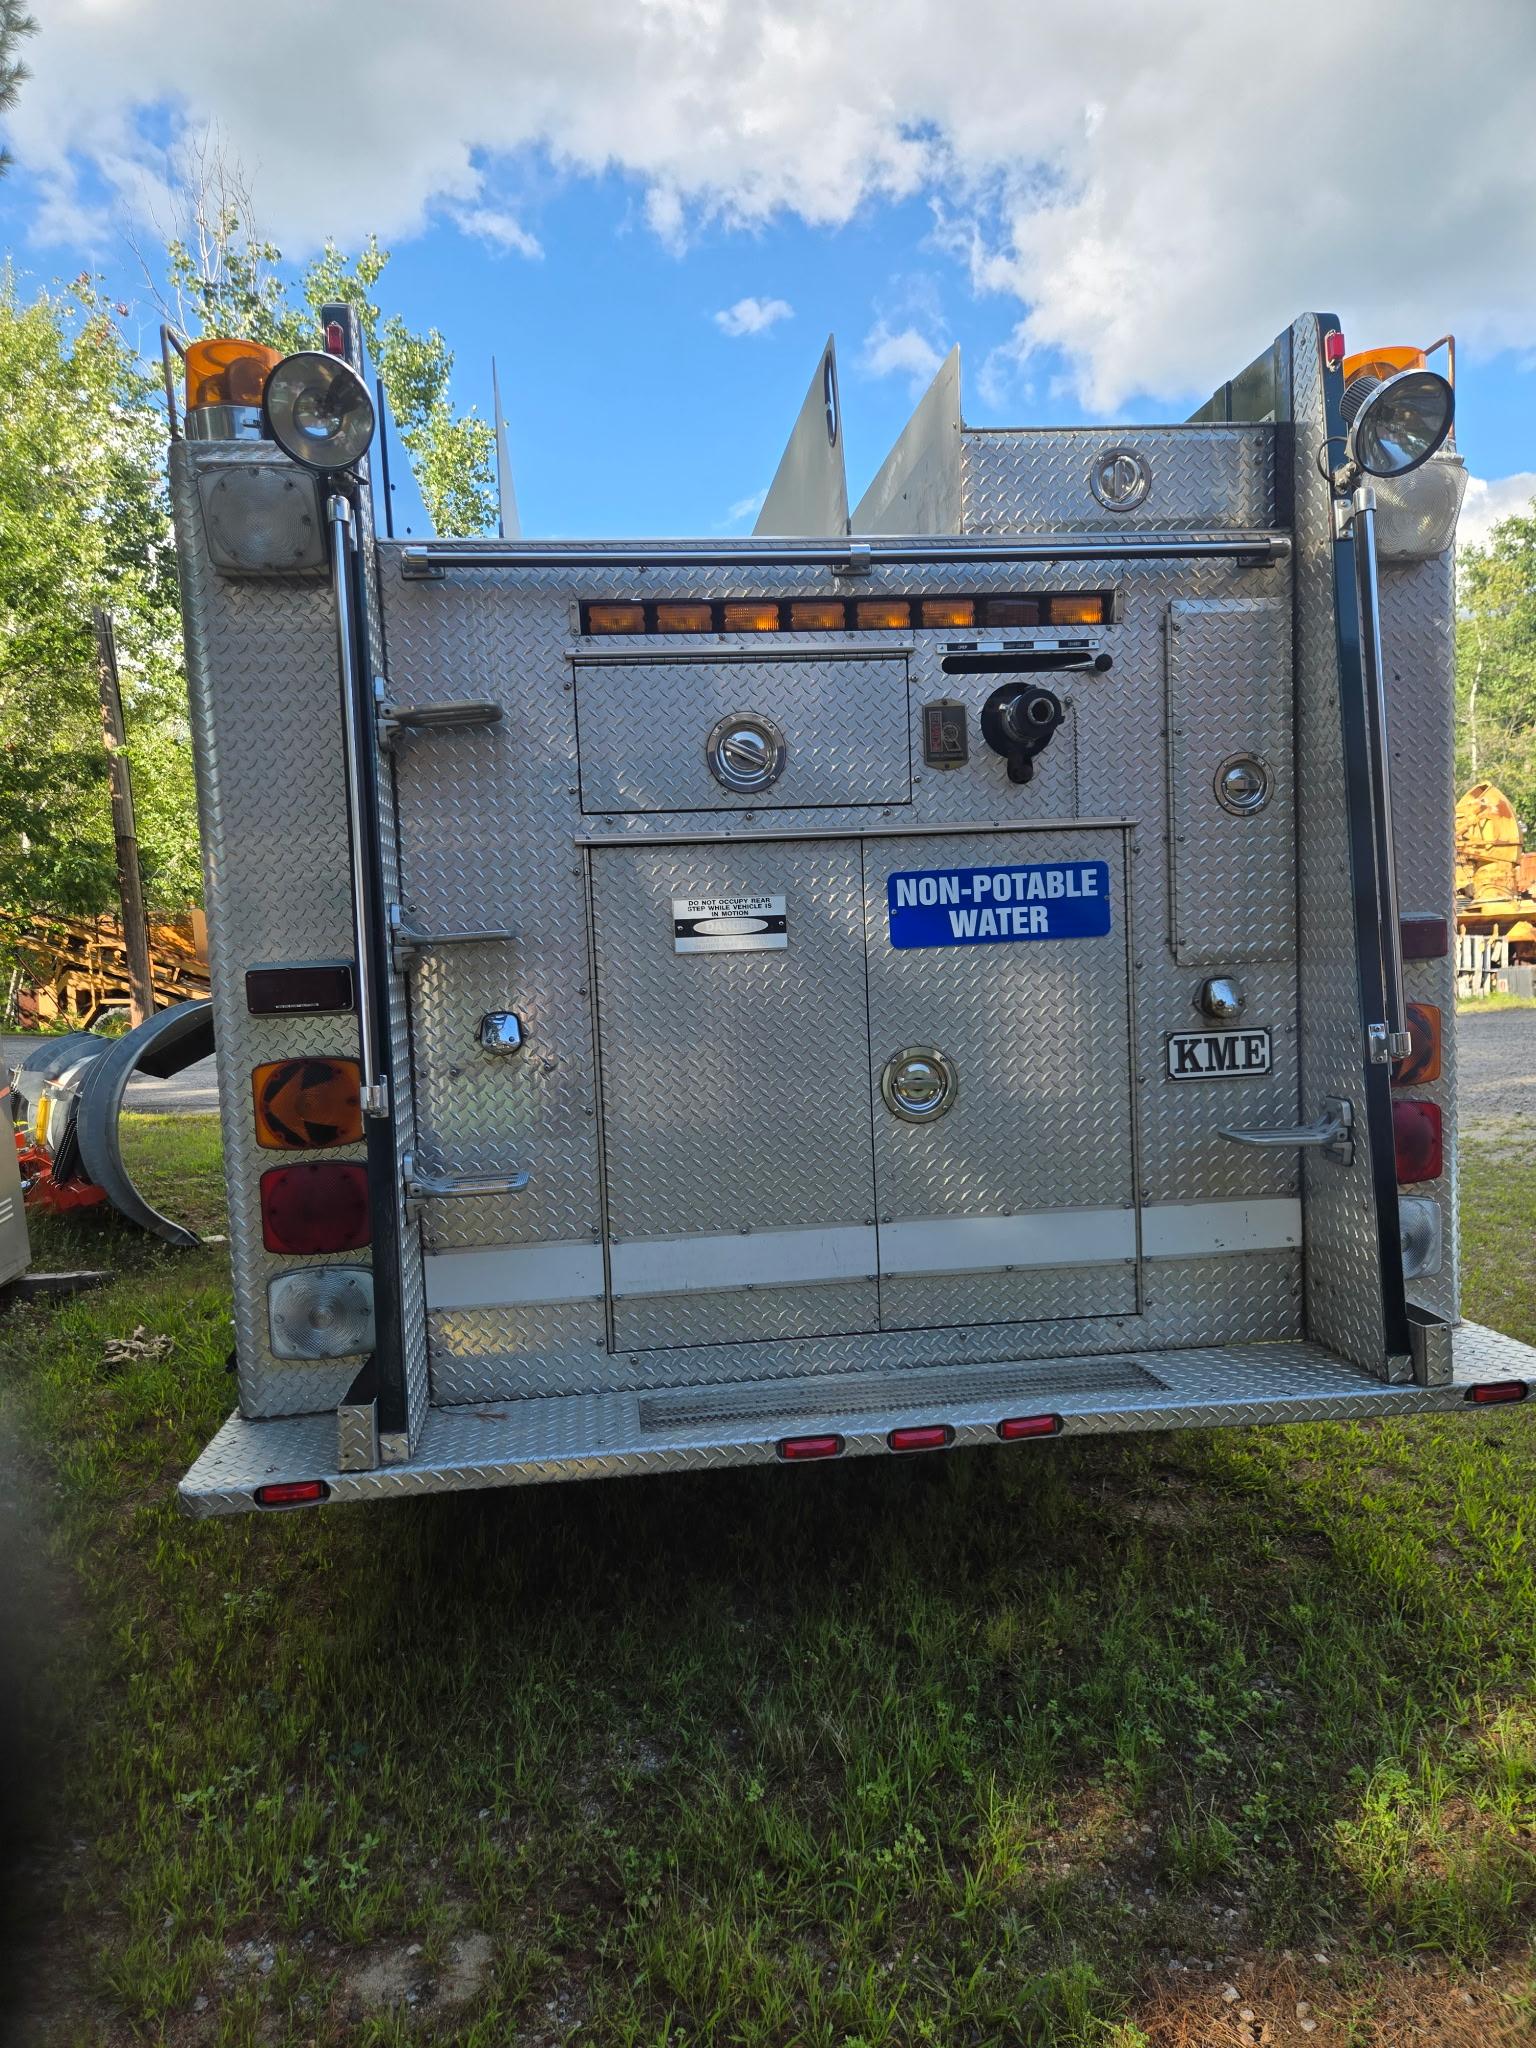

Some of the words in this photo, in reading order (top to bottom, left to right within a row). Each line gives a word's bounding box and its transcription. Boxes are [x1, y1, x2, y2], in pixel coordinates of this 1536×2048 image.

[896, 868, 1098, 907] NON-POTABLE
[949, 905, 1049, 938] WATER
[1173, 1034, 1266, 1074] KME
